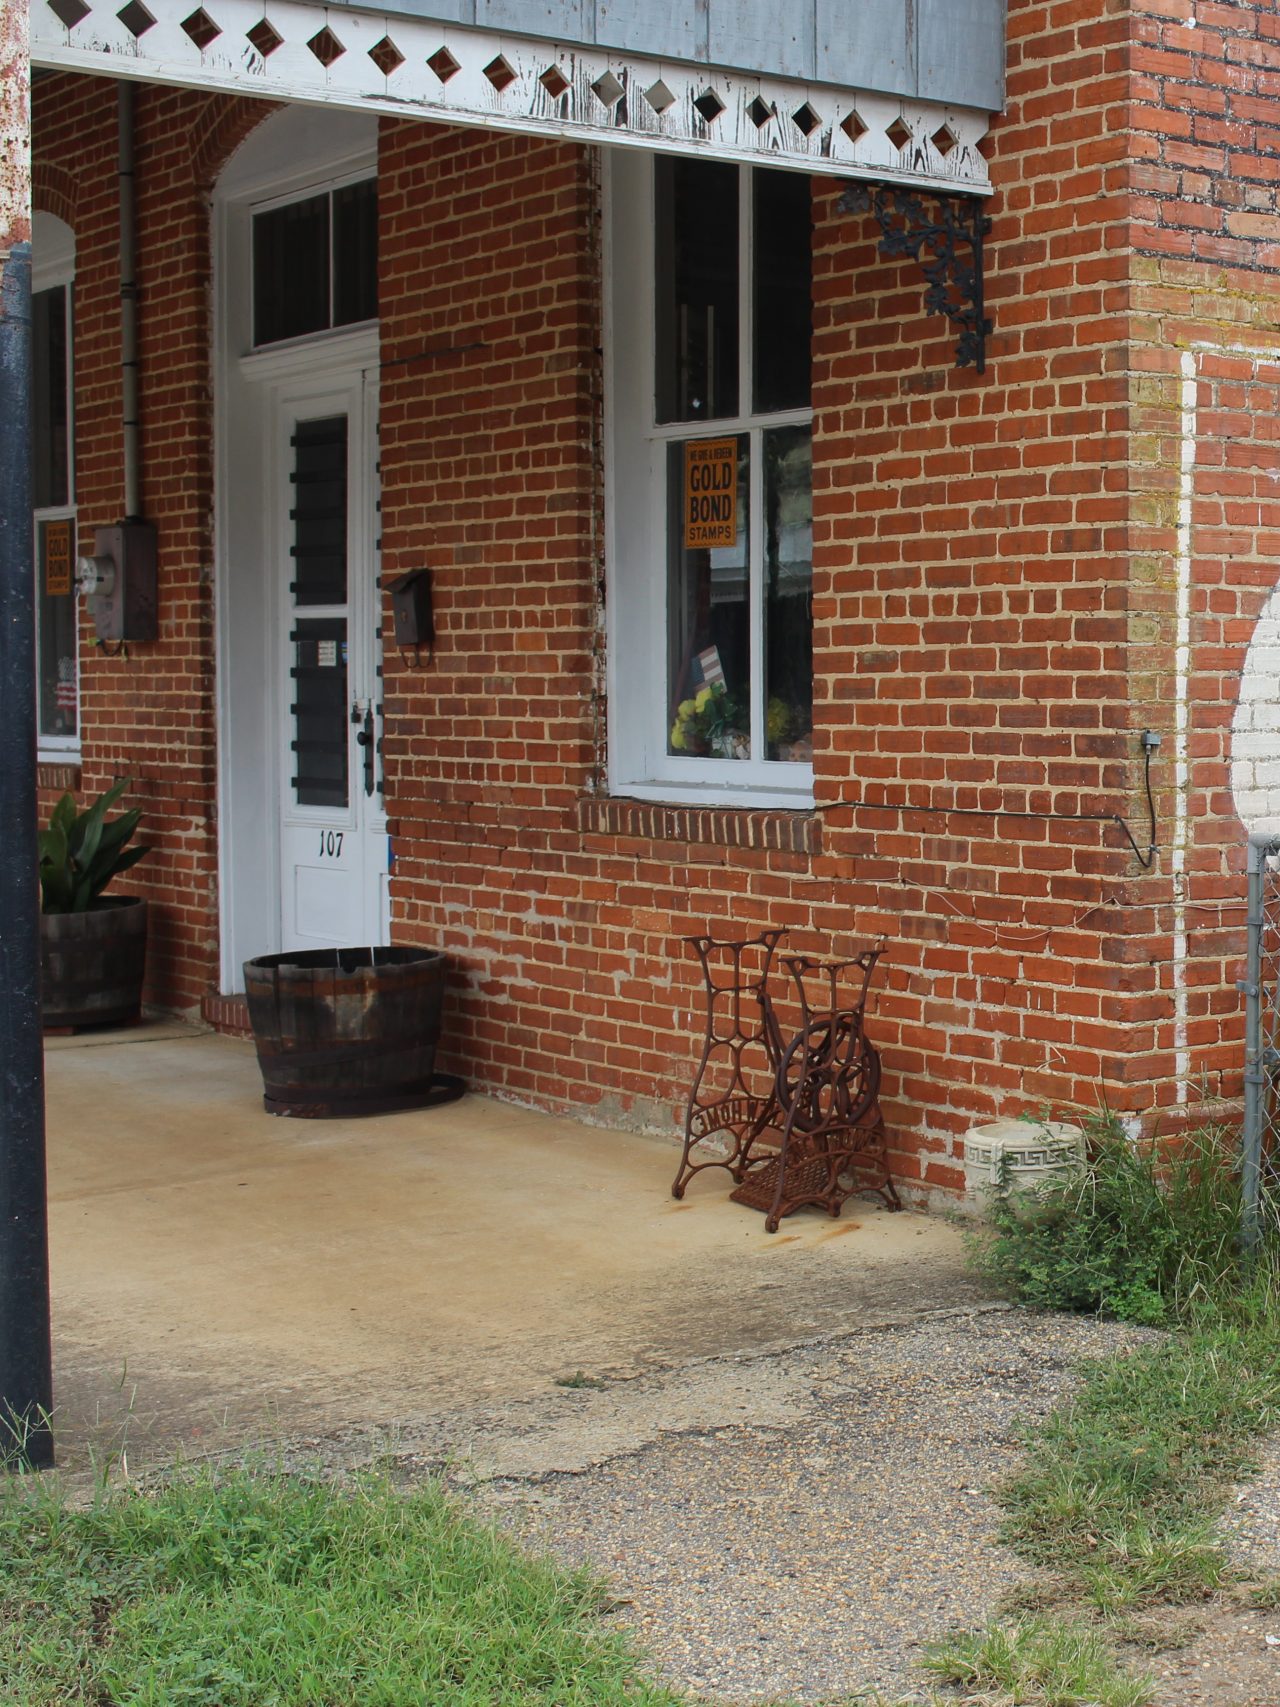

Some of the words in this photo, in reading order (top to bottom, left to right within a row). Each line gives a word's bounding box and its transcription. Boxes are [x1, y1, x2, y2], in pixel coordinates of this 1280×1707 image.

[690, 462, 732, 492] GOLD
[690, 494, 732, 523] BOND
[689, 525, 731, 541] STAMPS
[318, 829, 344, 859] 107
